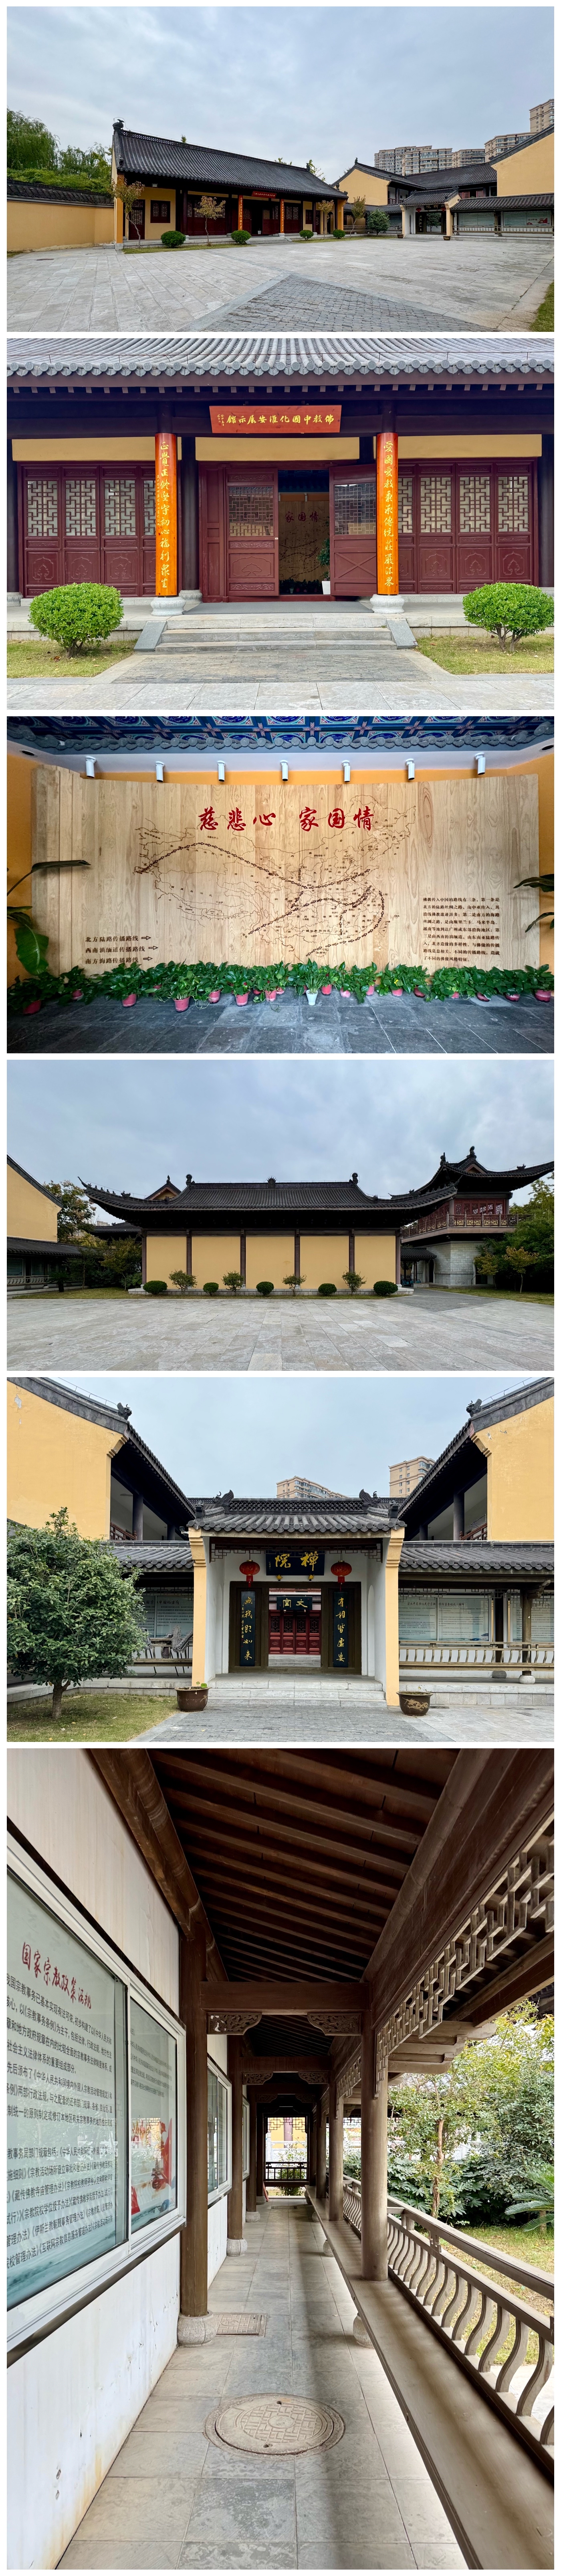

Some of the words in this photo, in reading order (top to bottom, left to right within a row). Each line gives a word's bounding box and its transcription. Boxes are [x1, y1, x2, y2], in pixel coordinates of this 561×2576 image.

[198, 806, 276, 831] 慈悲心
[299, 806, 374, 832] 家国情
[22, 1942, 91, 2009] 国家宗教政策法规
